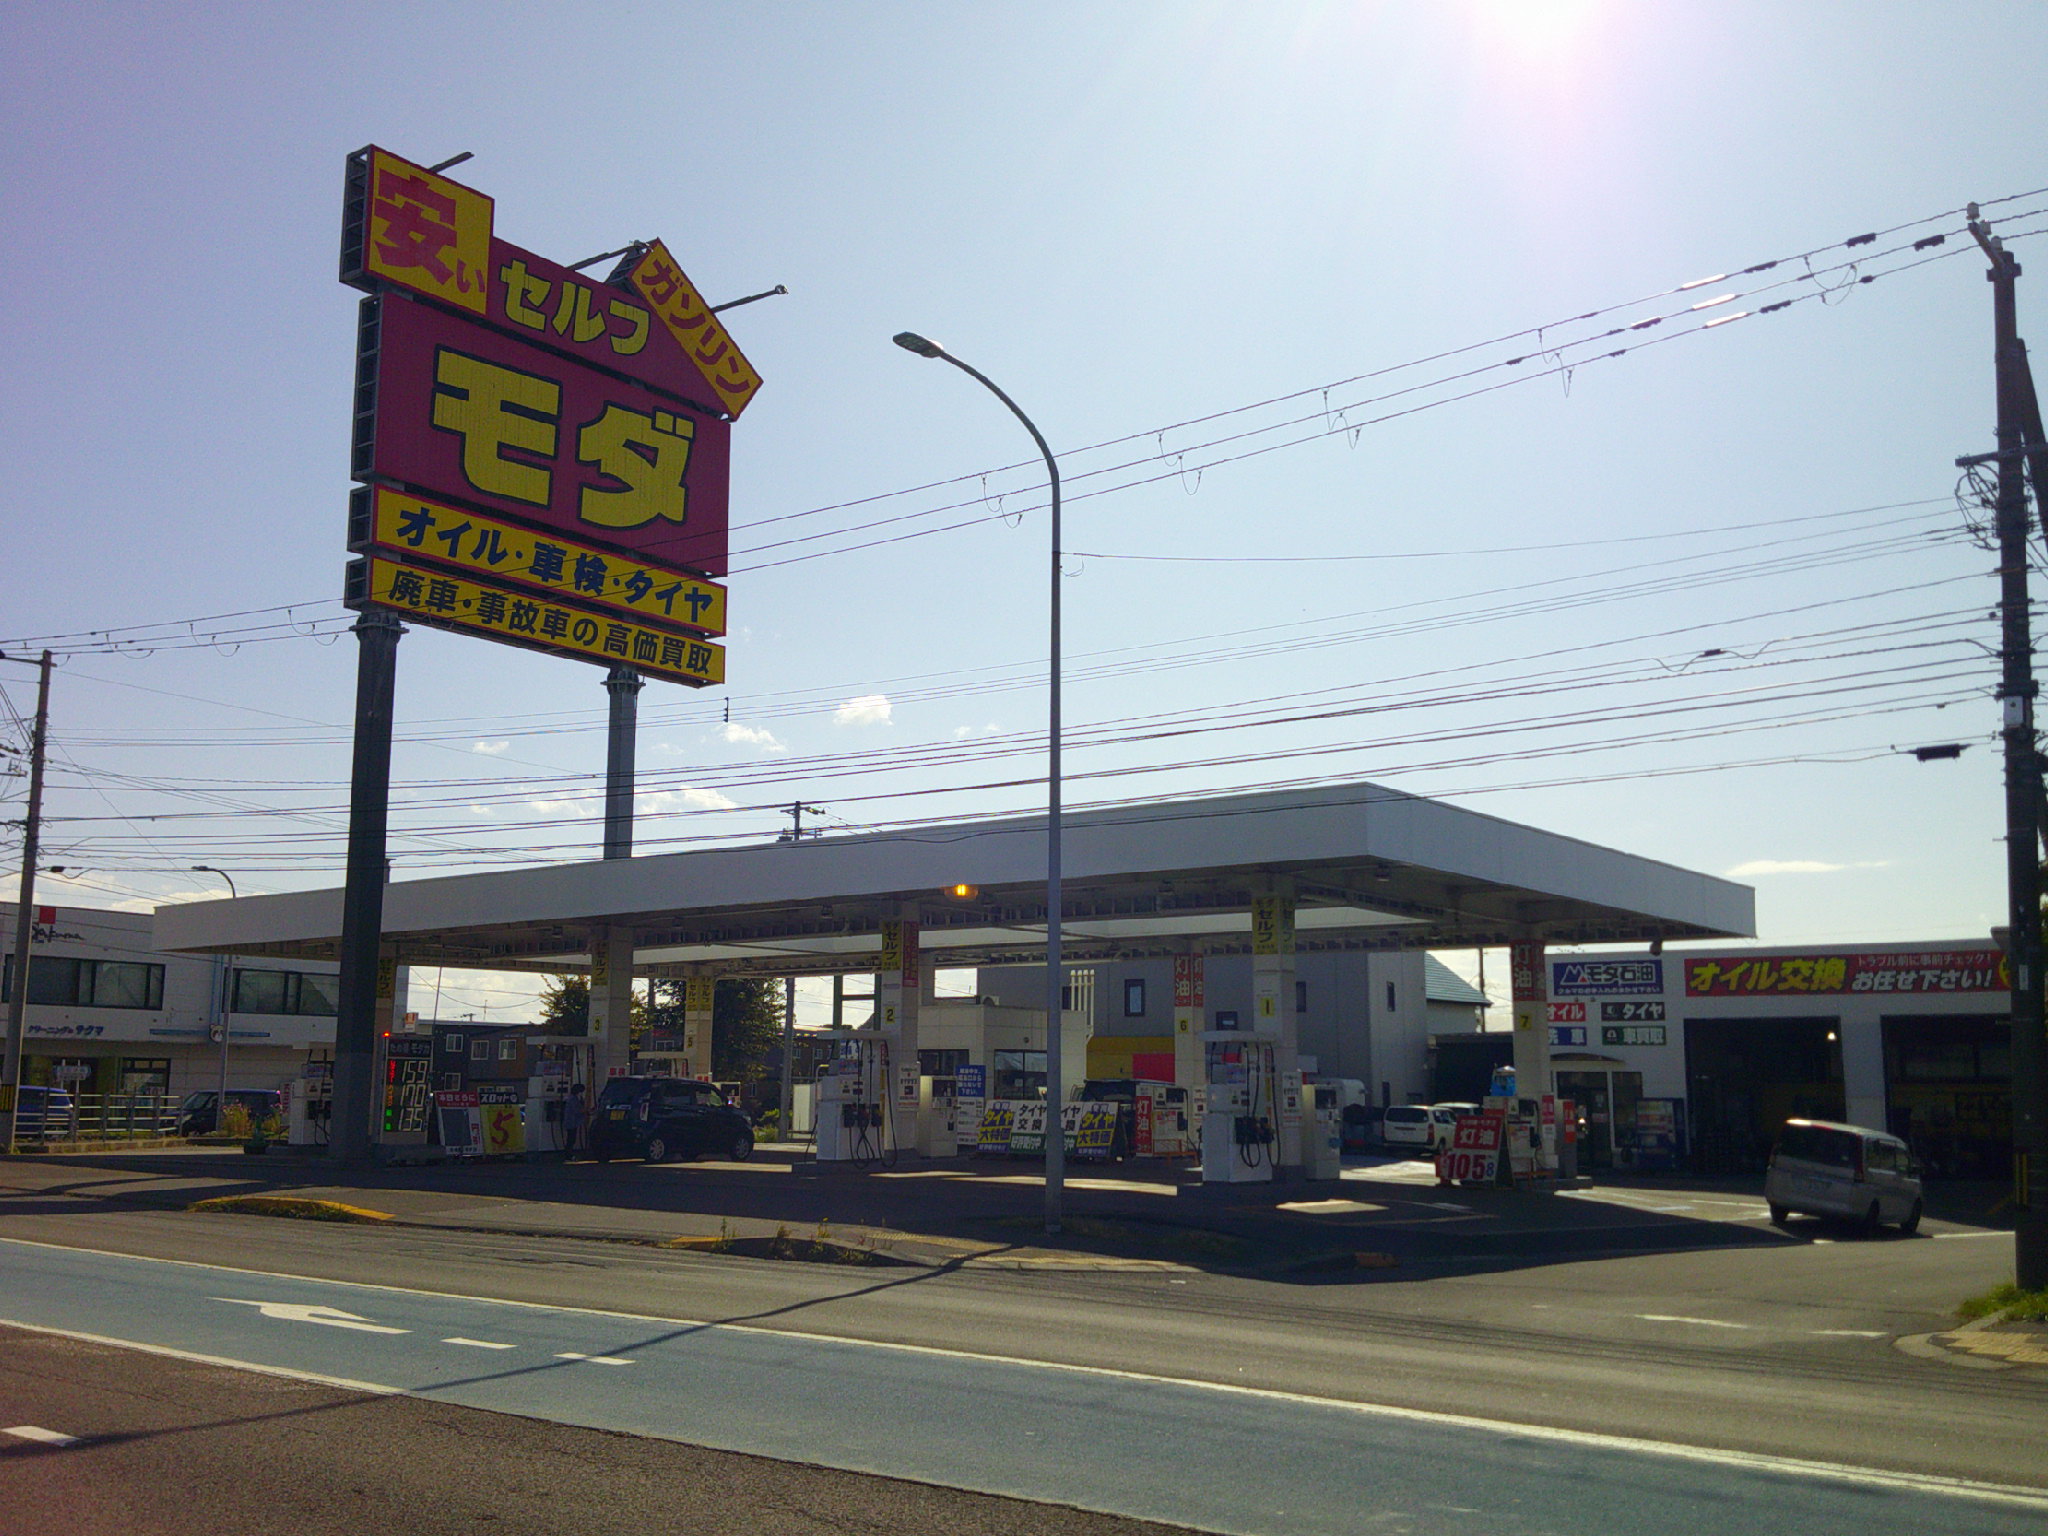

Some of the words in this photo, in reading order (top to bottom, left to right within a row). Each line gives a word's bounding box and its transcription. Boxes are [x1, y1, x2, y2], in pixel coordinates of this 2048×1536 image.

[374, 168, 485, 294] 安い
[501, 259, 651, 356] セルフ
[640, 258, 751, 394] ガソリン
[429, 343, 695, 530] モダ
[396, 507, 713, 622] オイル・車検・タイヤ
[388, 570, 713, 686] 廃車・事故車の高価買取
[884, 931, 898, 961] セルフ
[1175, 957, 1190, 997] 灯油
[1514, 945, 1532, 989] 灯油
[1689, 958, 1846, 991] オイル交換
[1851, 968, 1993, 991] お任せ下さい!
[886, 1008, 895, 1022] 2
[1520, 1015, 1529, 1028] 7
[1622, 1003, 1663, 1020] タイヤ
[1180, 1019, 1187, 1031] 6
[402, 1060, 428, 1084] 159
[400, 1084, 426, 1107] 170
[398, 1108, 423, 1132] 135
[983, 1109, 1014, 1125] タイヤ
[1019, 1103, 1047, 1117] タイヤ
[1061, 1105, 1080, 1118] イヤ
[1081, 1111, 1115, 1129] タイヤ
[1137, 1099, 1150, 1131] 灯油
[1018, 1118, 1042, 1131] 交換
[1460, 1127, 1496, 1146] 灯油
